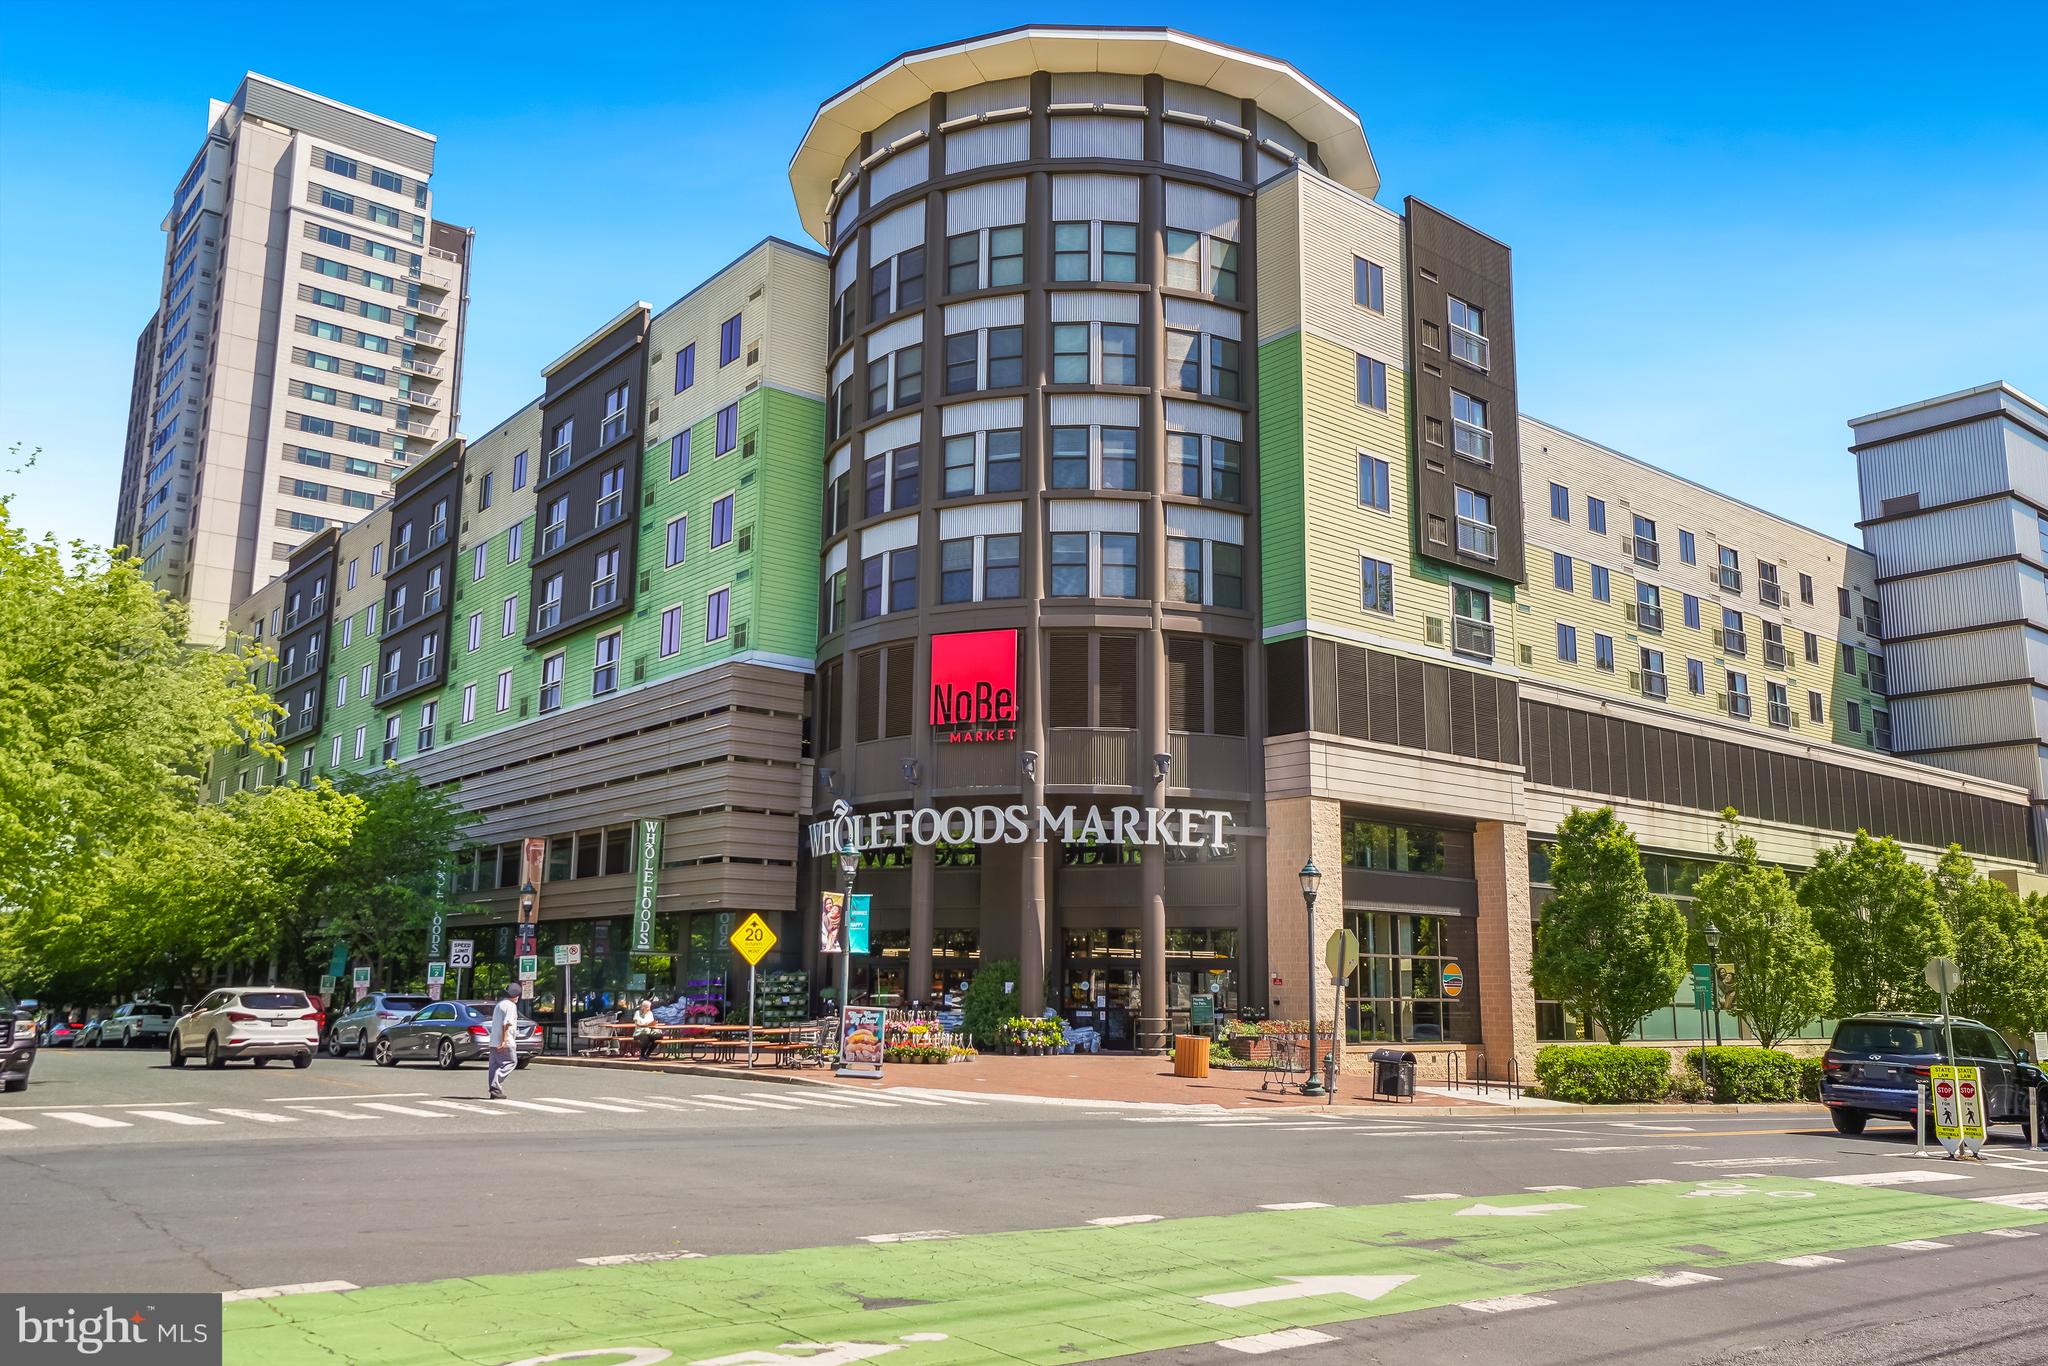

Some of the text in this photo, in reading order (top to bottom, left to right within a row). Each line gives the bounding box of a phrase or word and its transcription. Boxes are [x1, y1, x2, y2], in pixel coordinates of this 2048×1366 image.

[934, 682, 1012, 725] NoBe
[949, 729, 1016, 743] MARKET
[808, 799, 1233, 858] WHOLE FOODS MARKET
[643, 821, 658, 883] WHOLE
[431, 912, 442, 953] OODS
[639, 886, 653, 945] FOODS
[745, 928, 763, 941] 20
[453, 954, 470, 964] 20
